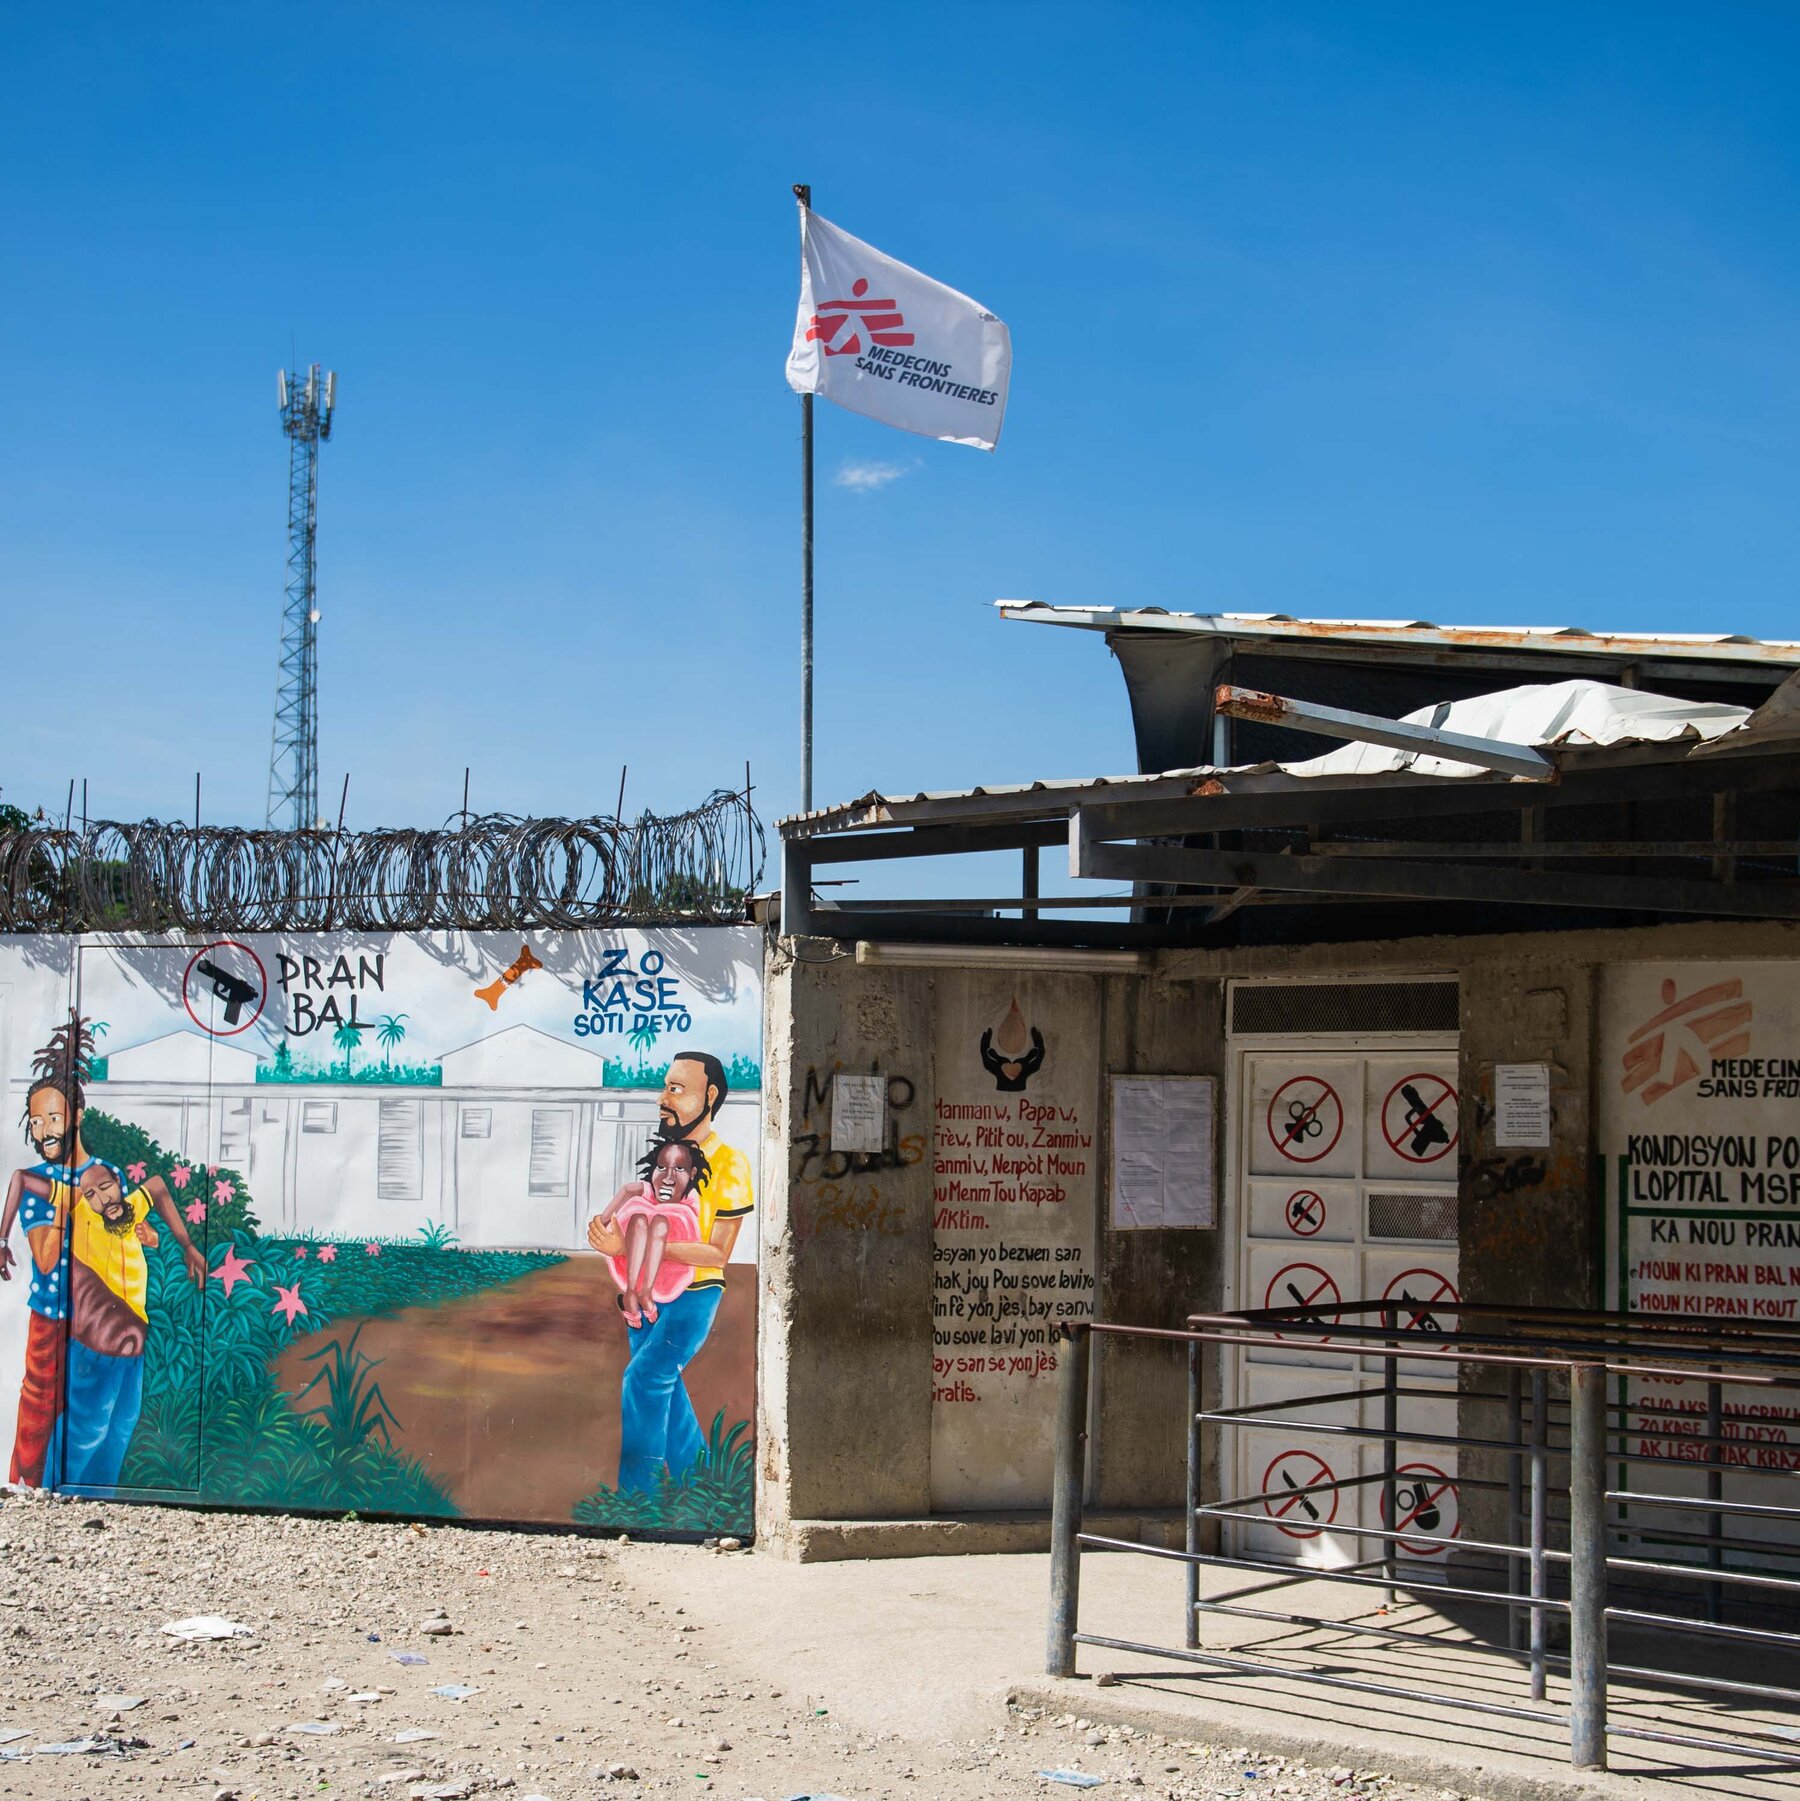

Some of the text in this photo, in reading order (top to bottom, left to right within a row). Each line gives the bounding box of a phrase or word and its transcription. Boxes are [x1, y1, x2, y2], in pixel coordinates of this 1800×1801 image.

[868, 345, 952, 377] MEDECINS
[855, 357, 999, 406] SANS FRONTIERES
[276, 953, 384, 993] PRAN
[598, 949, 664, 979] ZO
[583, 977, 686, 1012] KASE
[284, 993, 375, 1036] BAL
[1712, 1059, 1800, 1078] MEDECIN
[1697, 1079, 1758, 1098] SANS
[1019, 1099, 1056, 1126] Papa
[976, 1126, 1004, 1147] Pitit
[1006, 1132, 1029, 1149] ou,
[1628, 1134, 1756, 1168] KONDISYON
[992, 1154, 1044, 1181] Nenpòt
[1047, 1154, 1085, 1175] Moun
[949, 1180, 990, 1202] Menm
[989, 1181, 1016, 1202] Tou
[1019, 1182, 1066, 1208] Kapab
[1634, 1170, 1800, 1205] LOPITAL MSF
[1651, 1219, 1800, 1248] KA NOU PRAN
[979, 1248, 996, 1264] yo
[999, 1242, 1050, 1261] bezwen
[1055, 1247, 1081, 1261] san
[934, 1270, 961, 1290] hak
[962, 1268, 989, 1295] jou
[993, 1268, 1019, 1289] Pou
[1021, 1274, 1056, 1289] sove
[1639, 1261, 1680, 1281] MOUN
[1685, 1262, 1701, 1282] KI
[1705, 1263, 1748, 1284] PRAN
[1754, 1265, 1786, 1286] BAL
[932, 1295, 947, 1317] in
[968, 1301, 994, 1322] yon
[1029, 1296, 1053, 1320] bay
[1640, 1293, 1798, 1318] MOUN KI PRAN KOUT
[953, 1332, 987, 1345] sove
[991, 1322, 1016, 1345] lavi
[1020, 1329, 1044, 1349] yon
[957, 1355, 985, 1373] san
[989, 1356, 1006, 1371] se
[1009, 1356, 1032, 1375] yon
[1640, 1440, 1662, 1457] AK
